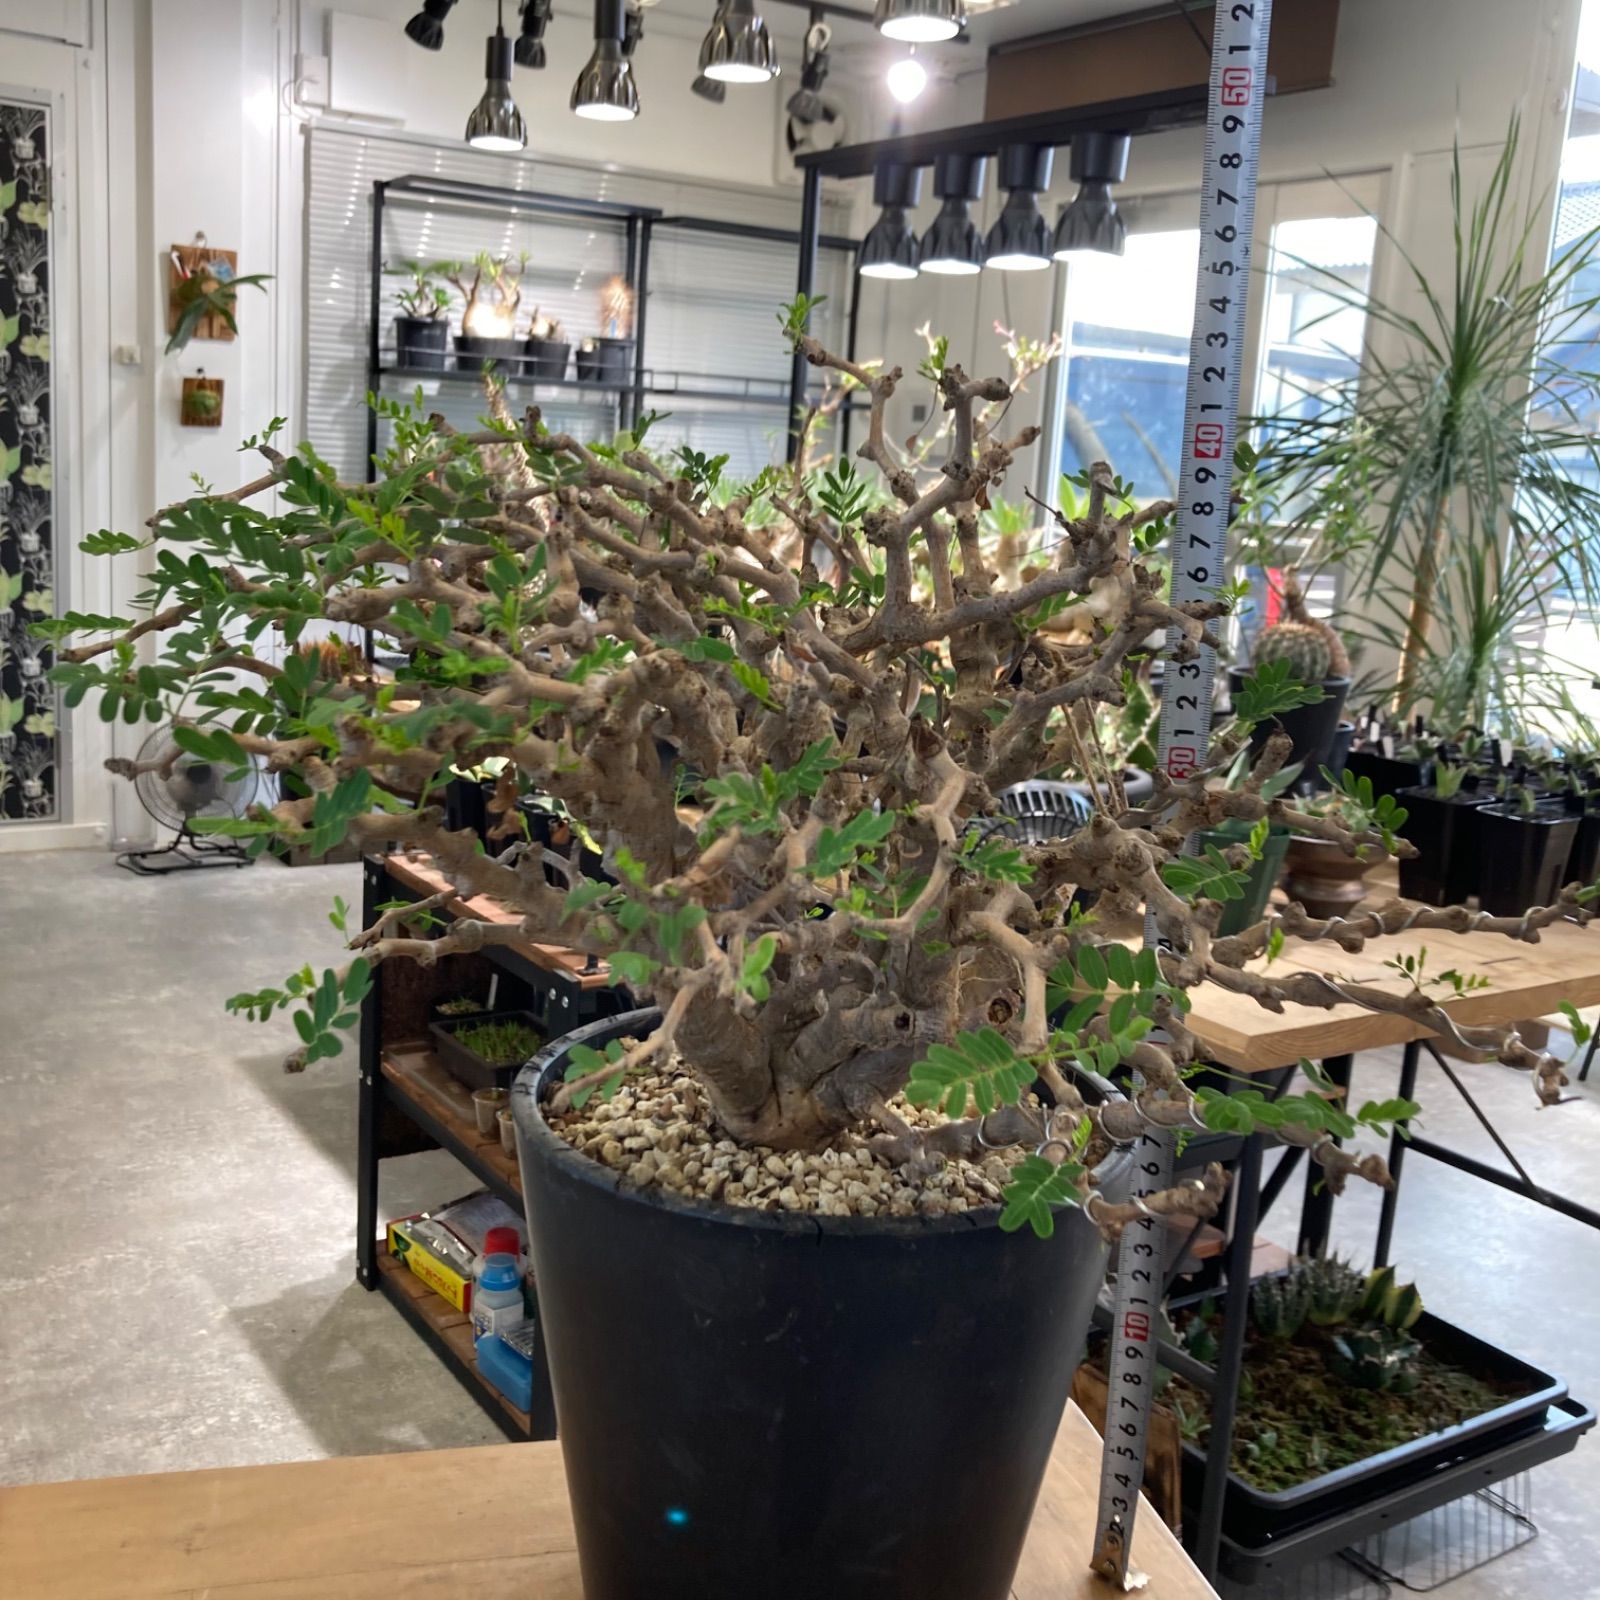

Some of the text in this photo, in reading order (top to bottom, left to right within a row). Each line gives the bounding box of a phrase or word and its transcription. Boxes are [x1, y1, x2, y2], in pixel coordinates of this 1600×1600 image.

[1231, 4, 1254, 22] 2
[1228, 45, 1251, 55] 1
[1223, 69, 1251, 104] 50
[1222, 114, 1245, 133] 9
[1219, 152, 1242, 169] 8
[1217, 188, 1239, 205] 7
[1214, 224, 1237, 243] 6
[1212, 260, 1234, 276] 5
[1209, 296, 1231, 314] 4
[1206, 331, 1228, 349] 3
[1203, 366, 1225, 382] 2
[1200, 403, 1222, 413] 1
[1195, 425, 1223, 458] 40
[1194, 467, 1217, 484] 9
[1192, 501, 1214, 516] 8
[1189, 533, 1211, 549] 7
[1186, 566, 1208, 583] 6
[1178, 663, 1200, 680] 3
[1176, 695, 1198, 710] 2
[1173, 728, 1195, 737] 1
[1169, 748, 1195, 778] 30
[1142, 1133, 1162, 1148] 7
[1140, 1161, 1160, 1176] 6
[1136, 1216, 1156, 1231] 4
[1133, 1243, 1153, 1257] 3
[1131, 1269, 1151, 1283] 2
[1130, 1296, 1148, 1305] 1
[1125, 1312, 1149, 1341] 10
[1125, 1345, 1144, 1361] 9
[1123, 1372, 1142, 1386] 8
[1121, 1397, 1139, 1412] 7
[1118, 1422, 1137, 1437] 6
[1116, 1446, 1135, 1461] 5
[1114, 1472, 1132, 1488] 4
[1112, 1496, 1128, 1512] 3
